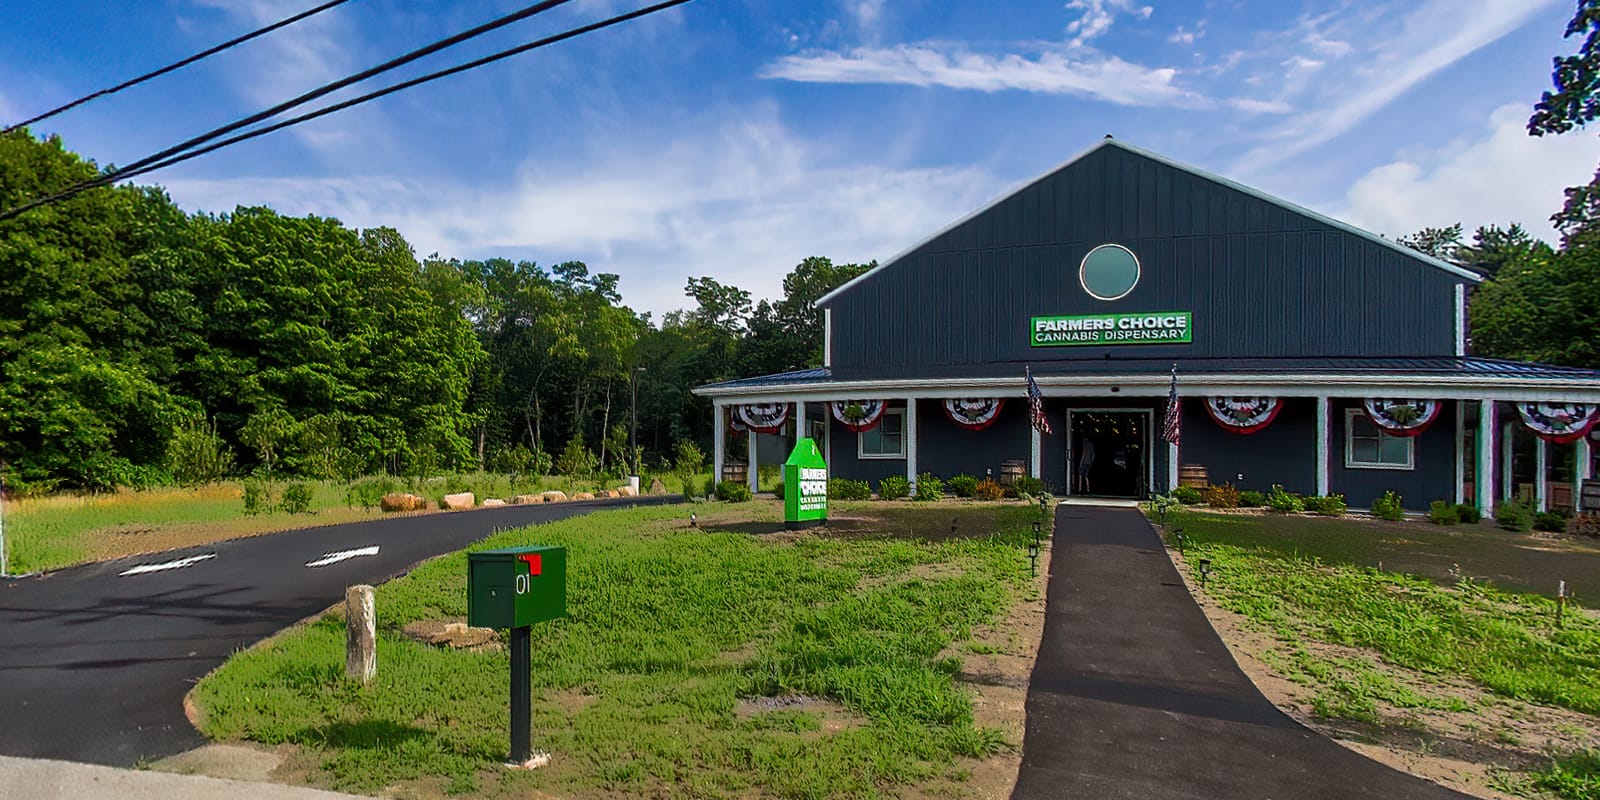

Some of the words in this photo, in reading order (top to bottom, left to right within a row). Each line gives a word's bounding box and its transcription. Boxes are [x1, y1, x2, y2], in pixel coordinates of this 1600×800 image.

[1035, 318, 1115, 332] FARMERS
[1118, 316, 1186, 330] CHOICE
[1035, 331, 1099, 342] CANNABIS
[1104, 329, 1187, 340] DISPENSARY
